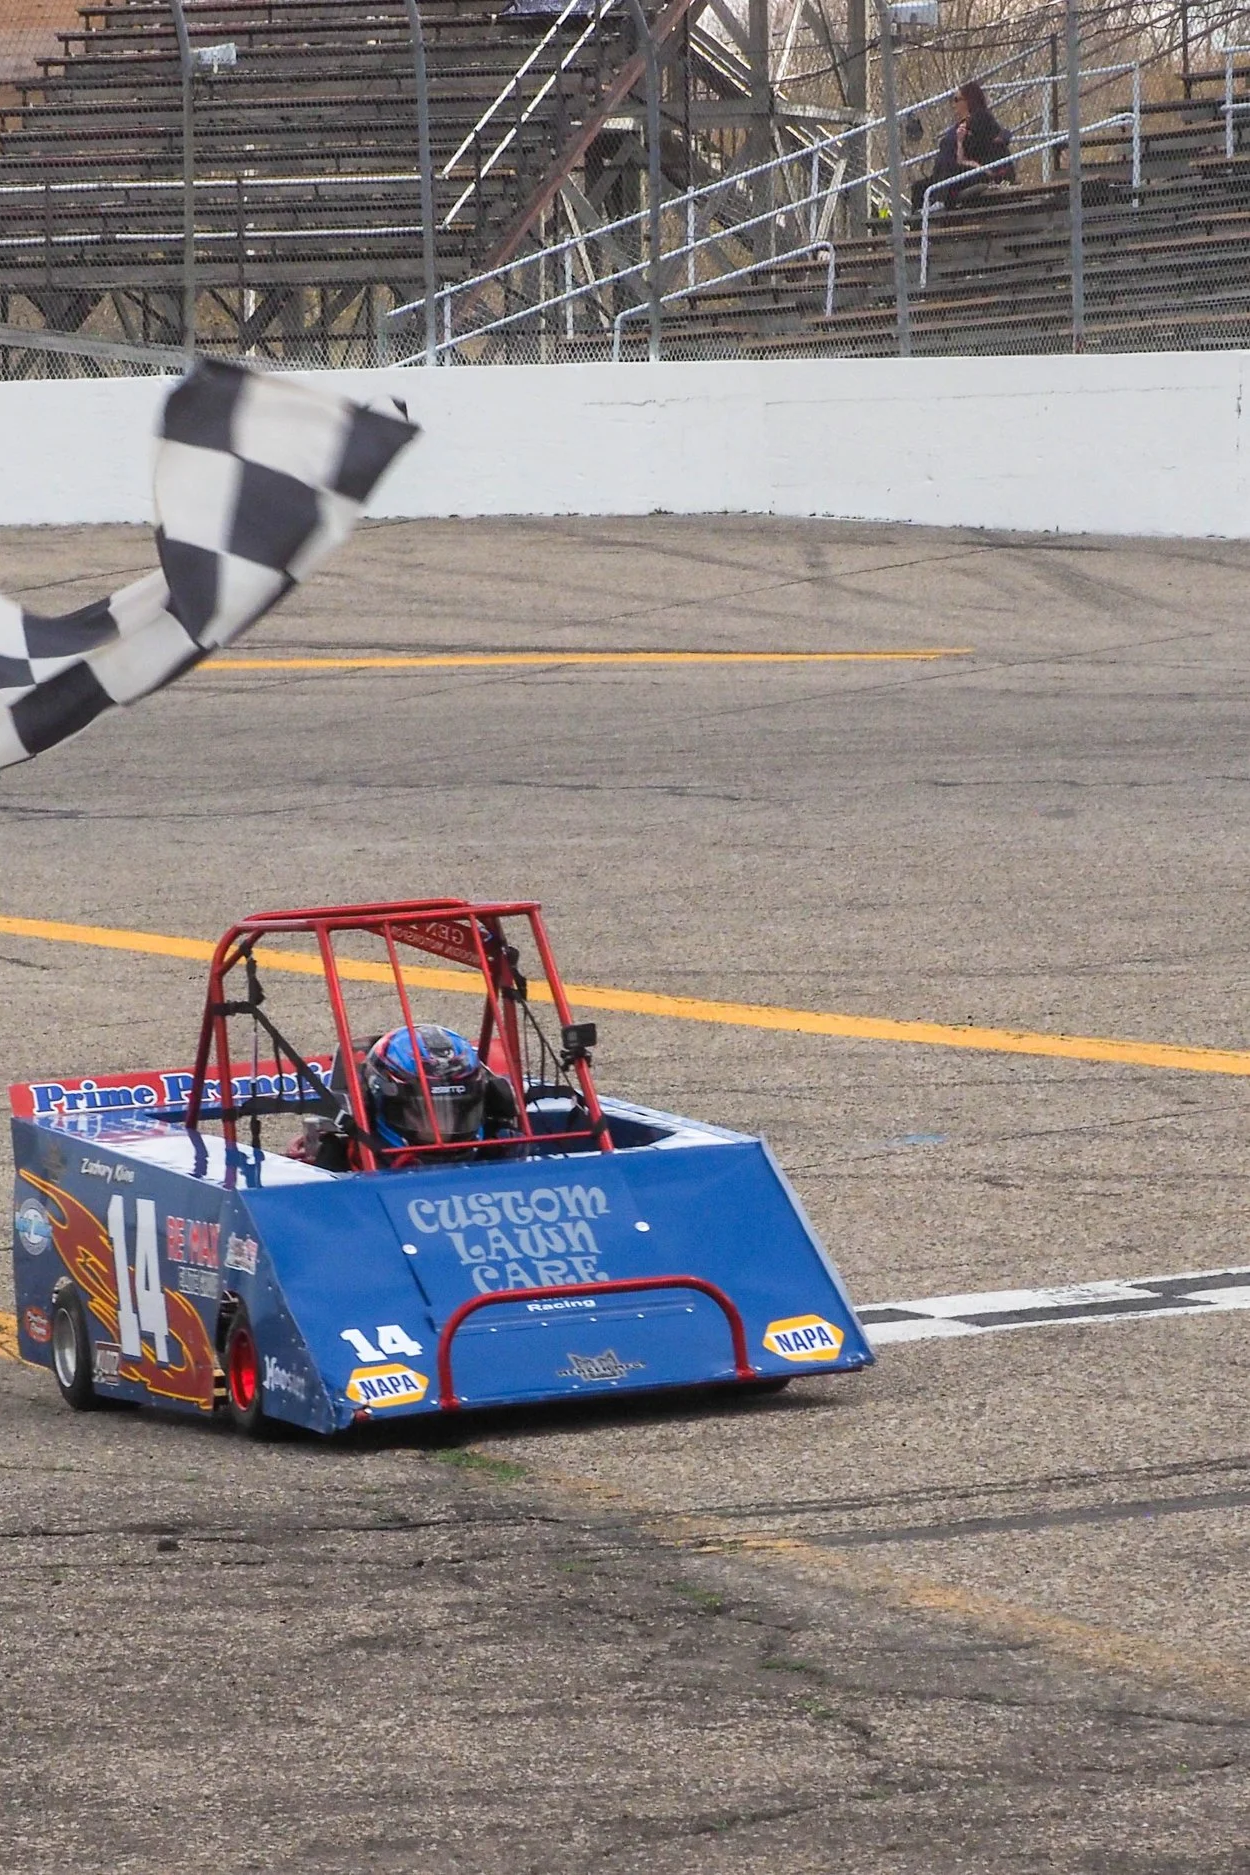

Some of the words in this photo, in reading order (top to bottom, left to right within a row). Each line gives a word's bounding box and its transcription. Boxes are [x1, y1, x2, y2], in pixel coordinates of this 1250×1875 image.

[29, 1079, 157, 1115] Prime
[408, 1184, 610, 1233] CUSTOM
[447, 1220, 602, 1266] LAWN
[108, 1194, 169, 1366] 14
[527, 1299, 596, 1312] Racing
[340, 1324, 424, 1362] 14
[774, 1325, 834, 1353] NAPA
[359, 1374, 419, 1400] NAPA
